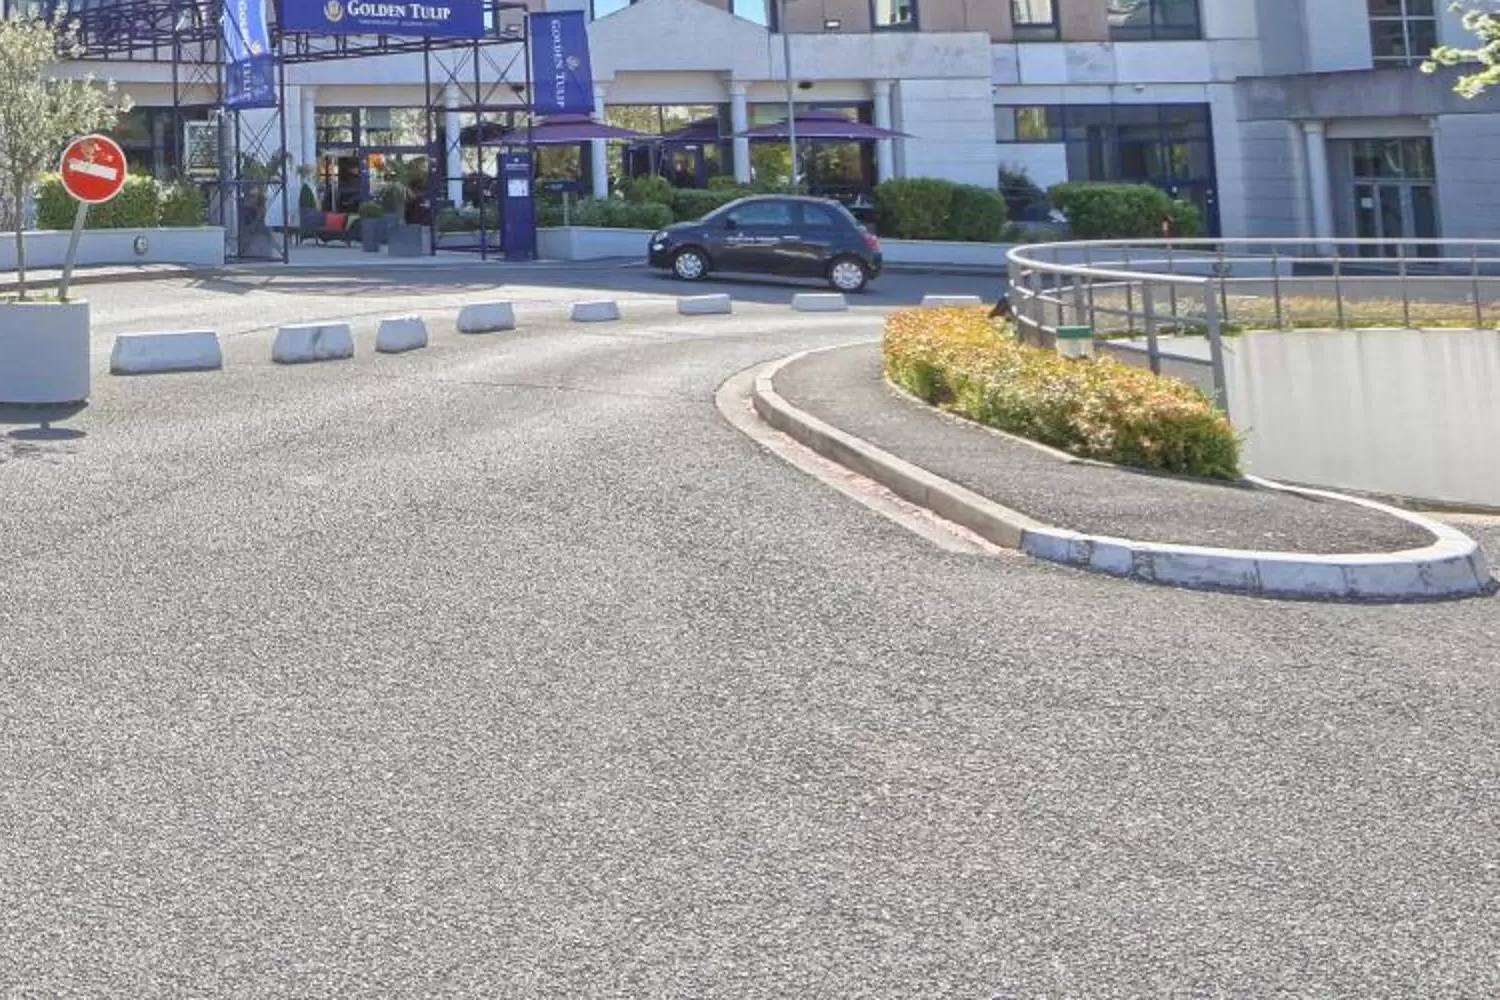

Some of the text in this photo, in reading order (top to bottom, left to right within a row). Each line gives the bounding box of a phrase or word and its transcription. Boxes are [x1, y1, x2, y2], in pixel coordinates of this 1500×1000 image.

[347, 0, 451, 20] GOLDEN TULIP
[555, 71, 565, 108] TULIP
